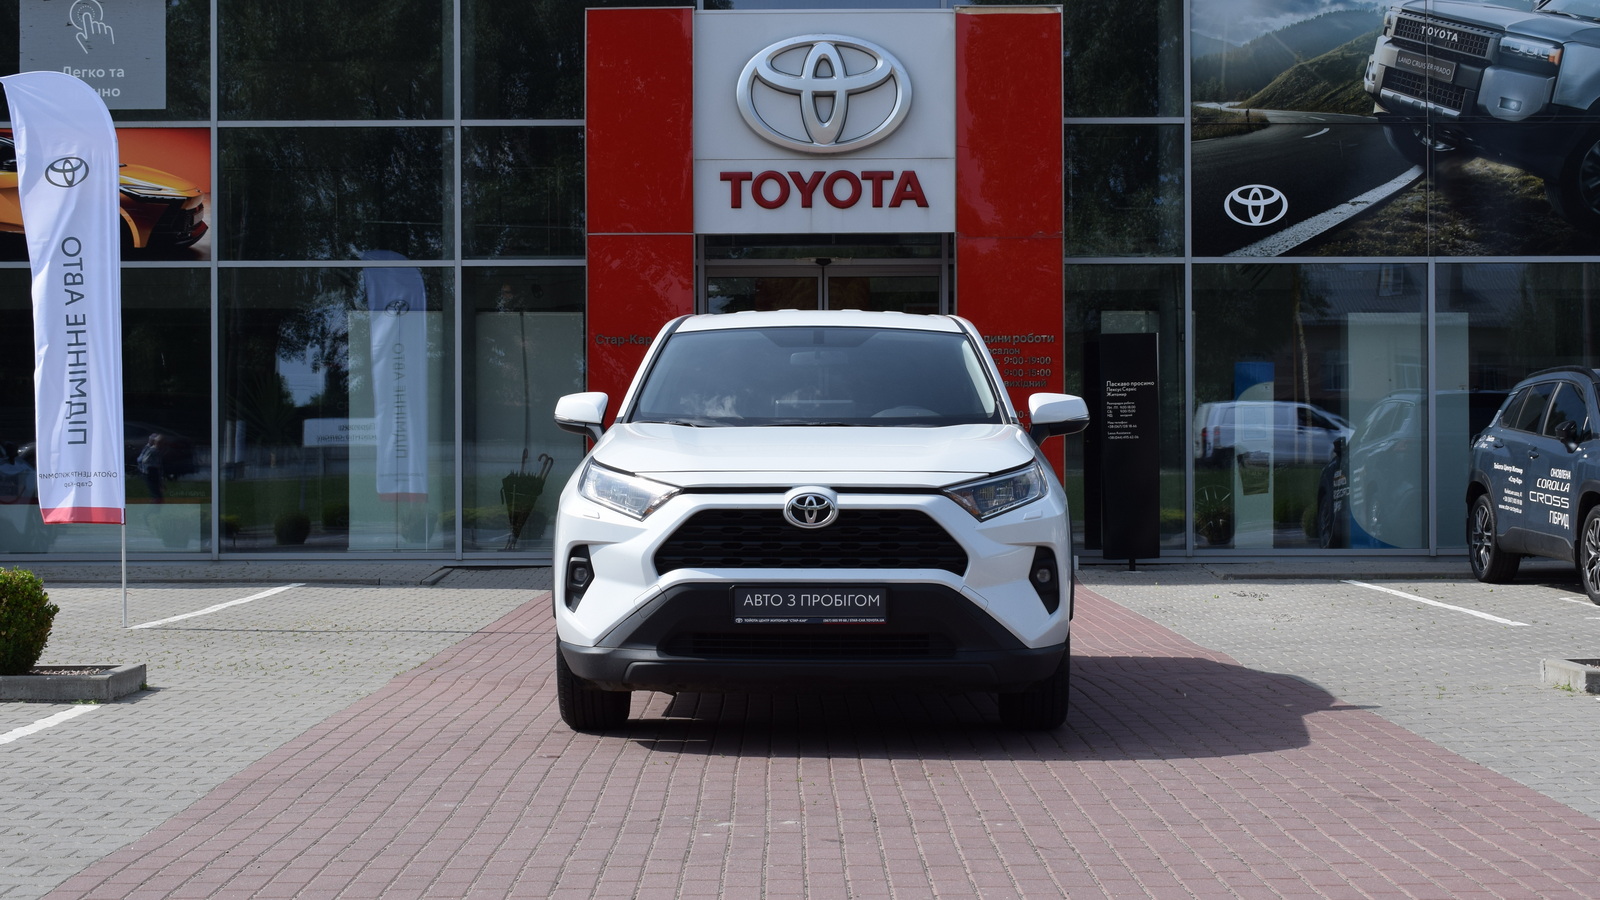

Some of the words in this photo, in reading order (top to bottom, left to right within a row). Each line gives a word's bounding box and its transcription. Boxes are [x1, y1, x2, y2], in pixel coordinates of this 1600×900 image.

[1421, 26, 1458, 42] TOYOTA
[63, 66, 105, 78] Легко
[109, 68, 125, 78] та
[1398, 56, 1411, 65] LAND
[1411, 59, 1434, 70] CRUISER
[1434, 65, 1451, 76] PRADO
[720, 170, 930, 209] TOYOTA
[595, 334, 653, 347] Стар-Кар
[983, 335, 1011, 344] дини
[1012, 333, 1055, 345] роботи
[1536, 478, 1570, 493] COROLLA
[1529, 491, 1570, 509] CROSS
[1548, 510, 1570, 530] ГІБРИД
[743, 594, 783, 607] АВТО
[800, 594, 880, 607] ПРОБІГОМ
